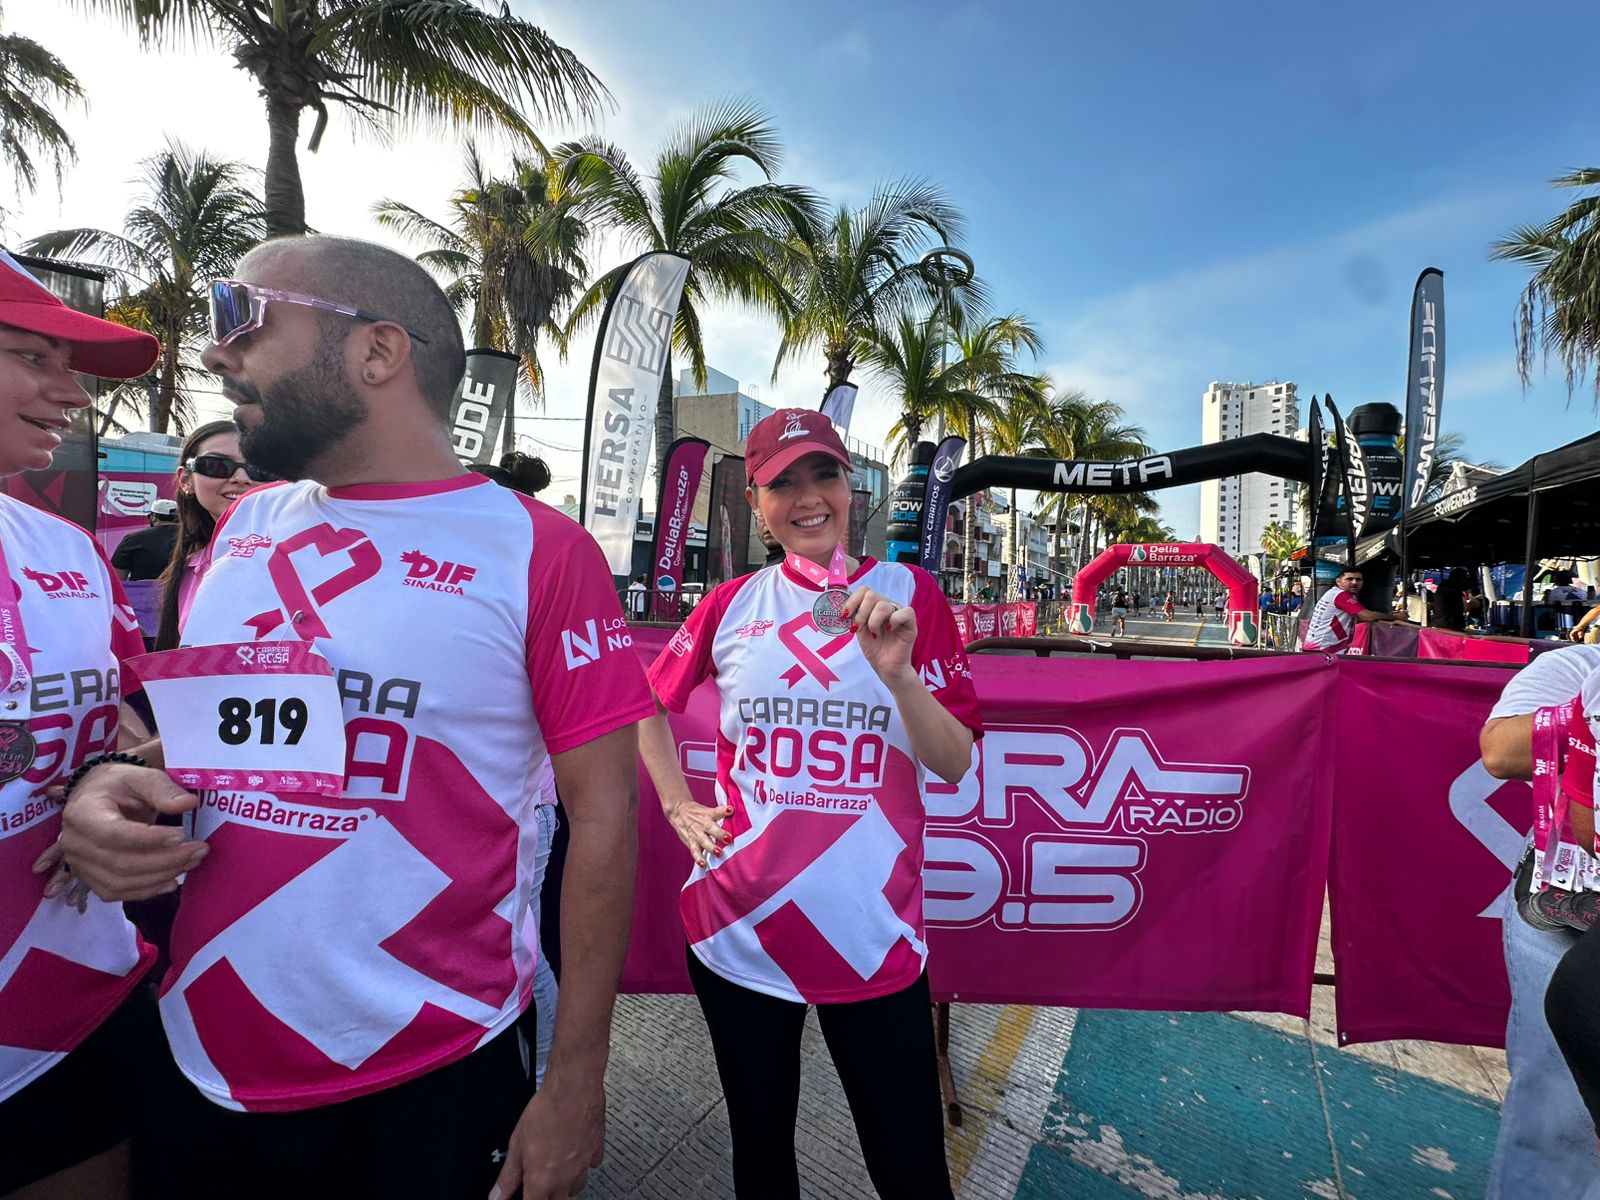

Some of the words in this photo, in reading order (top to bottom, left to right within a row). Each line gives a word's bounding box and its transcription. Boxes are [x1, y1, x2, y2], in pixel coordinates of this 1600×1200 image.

[594, 388, 635, 517] HERSA
[626, 404, 647, 503] CORPORATIVO
[1053, 456, 1173, 486] META
[926, 485, 941, 531] CERRITOS
[924, 534, 932, 560] VILLA
[1149, 545, 1179, 553] Delia
[1149, 553, 1195, 562] Barraza
[36, 571, 90, 592] DIF
[406, 555, 477, 585] DIF
[47, 590, 100, 600] SINALOA
[402, 578, 464, 596] SINALOA
[257, 653, 289, 664] ROSA
[218, 697, 308, 746] 819
[738, 697, 892, 733] CARRERA
[738, 726, 884, 783] ROSA
[1535, 758, 1547, 776] DIF
[206, 788, 360, 833] DeliaBarraza
[769, 788, 869, 811] DeliaBarraza
[1130, 805, 1236, 826] RADIO
